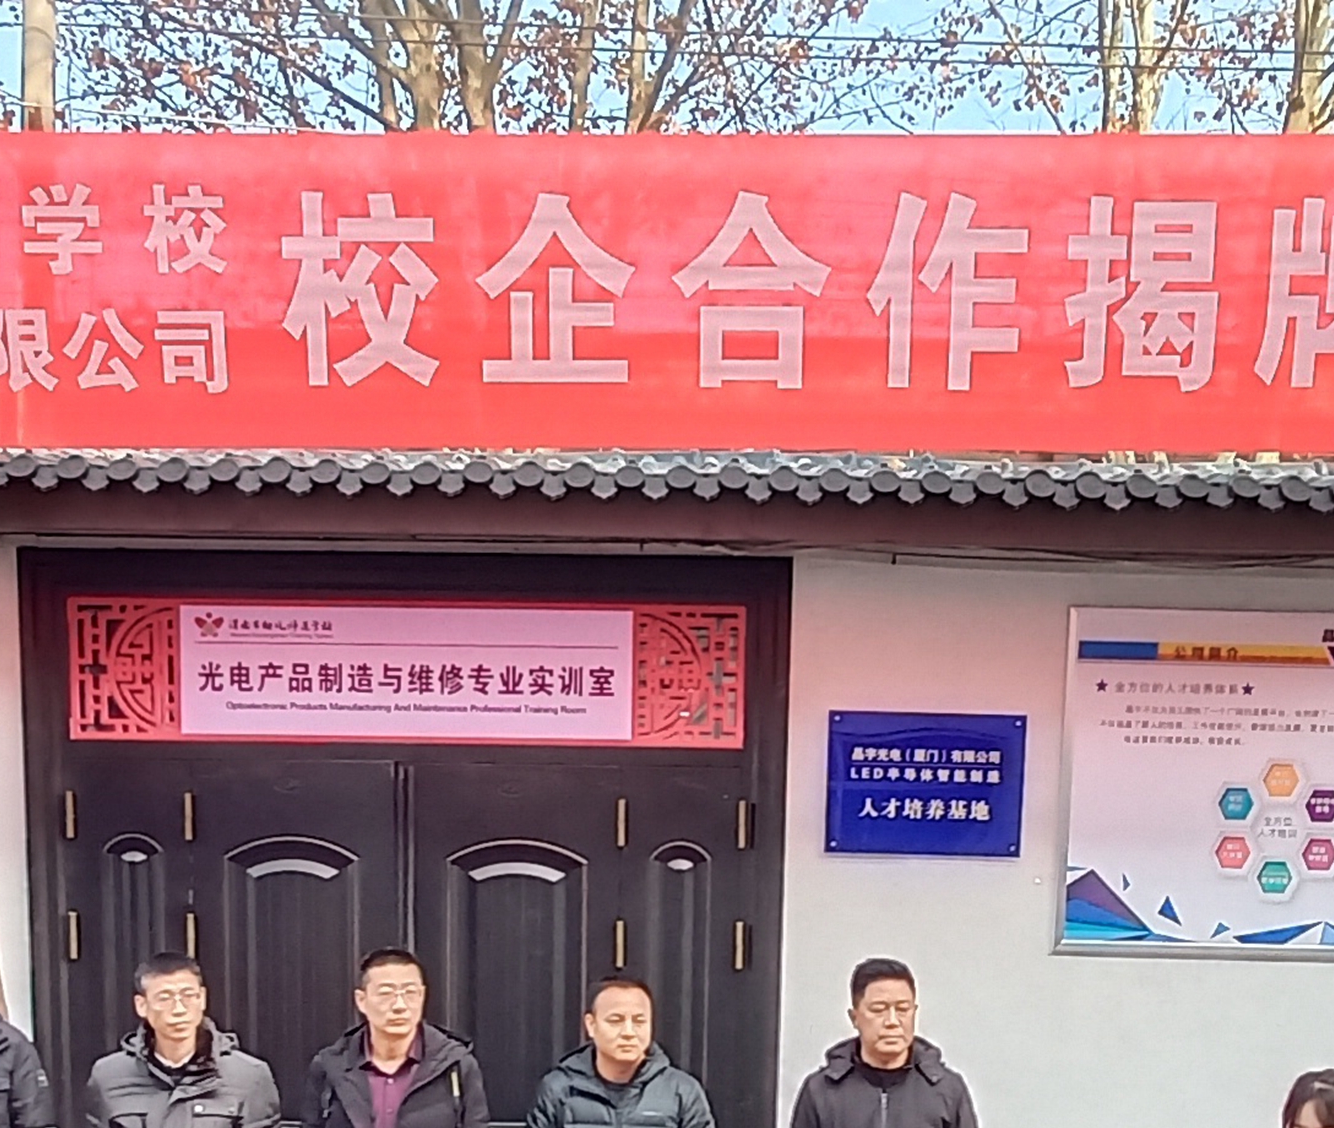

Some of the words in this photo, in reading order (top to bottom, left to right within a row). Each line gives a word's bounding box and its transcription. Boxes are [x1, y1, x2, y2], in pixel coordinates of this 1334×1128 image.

[198, 661, 616, 697] 光电产品制造与维修专业实训室
[290, 702, 328, 711] Products
[330, 703, 392, 713] Manufacturing
[394, 703, 411, 711] And
[524, 705, 558, 715] Training
[561, 705, 587, 714] Room
[851, 747, 1001, 764] 晶宇光电（厦门）有限公司
[858, 797, 991, 821] 人才培养基地
